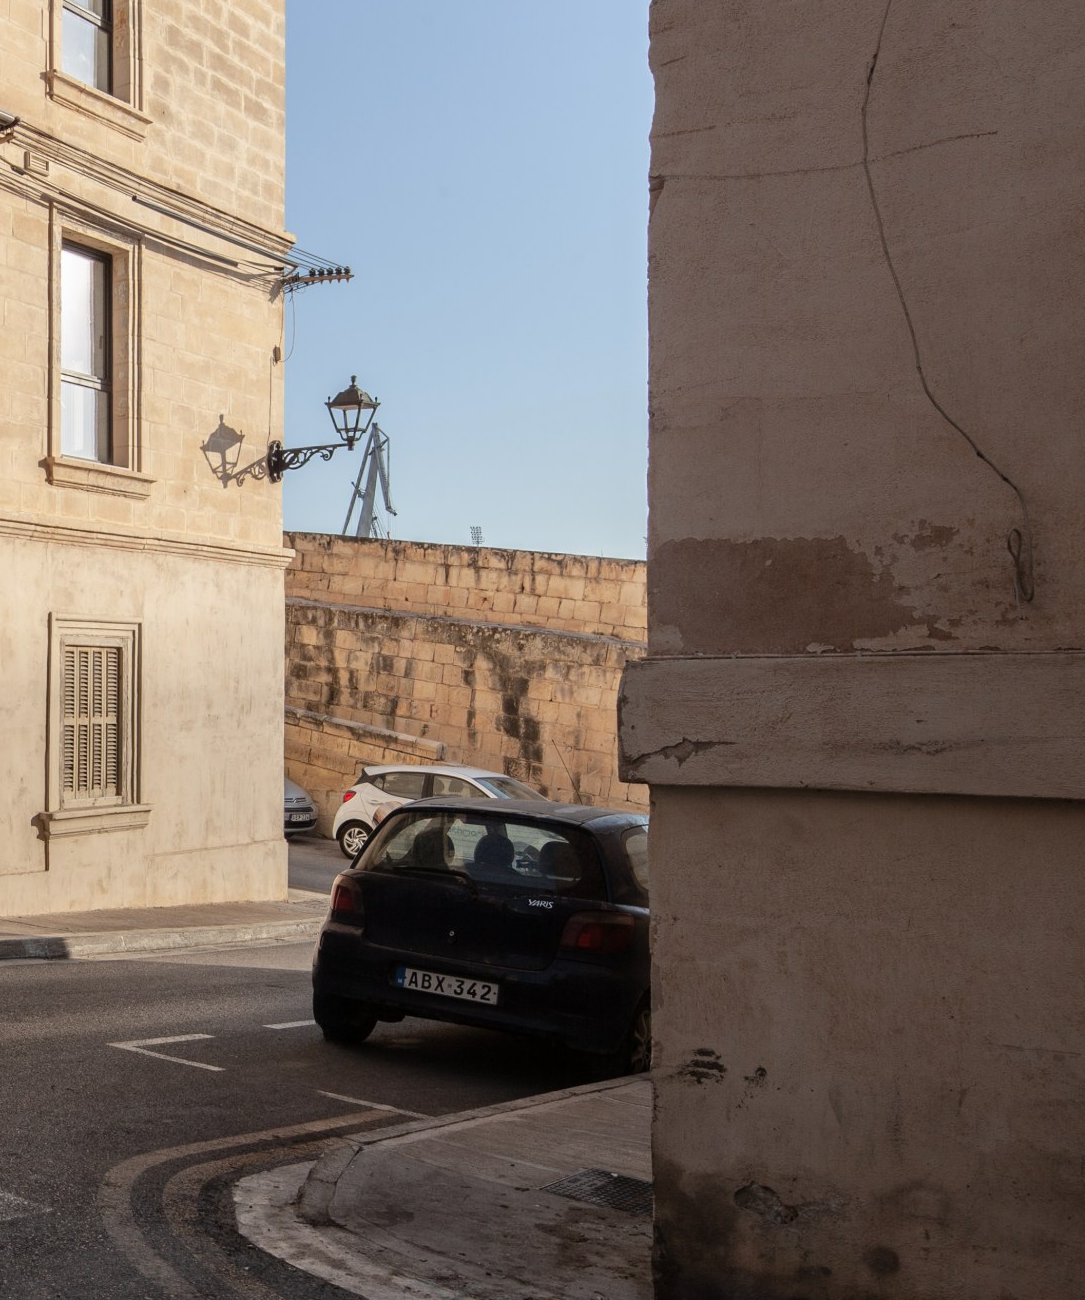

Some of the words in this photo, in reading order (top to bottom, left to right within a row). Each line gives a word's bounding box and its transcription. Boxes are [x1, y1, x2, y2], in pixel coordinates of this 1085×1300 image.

[528, 898, 554, 909] YARIS
[408, 971, 446, 993] ABX
[453, 979, 493, 1002] 342
